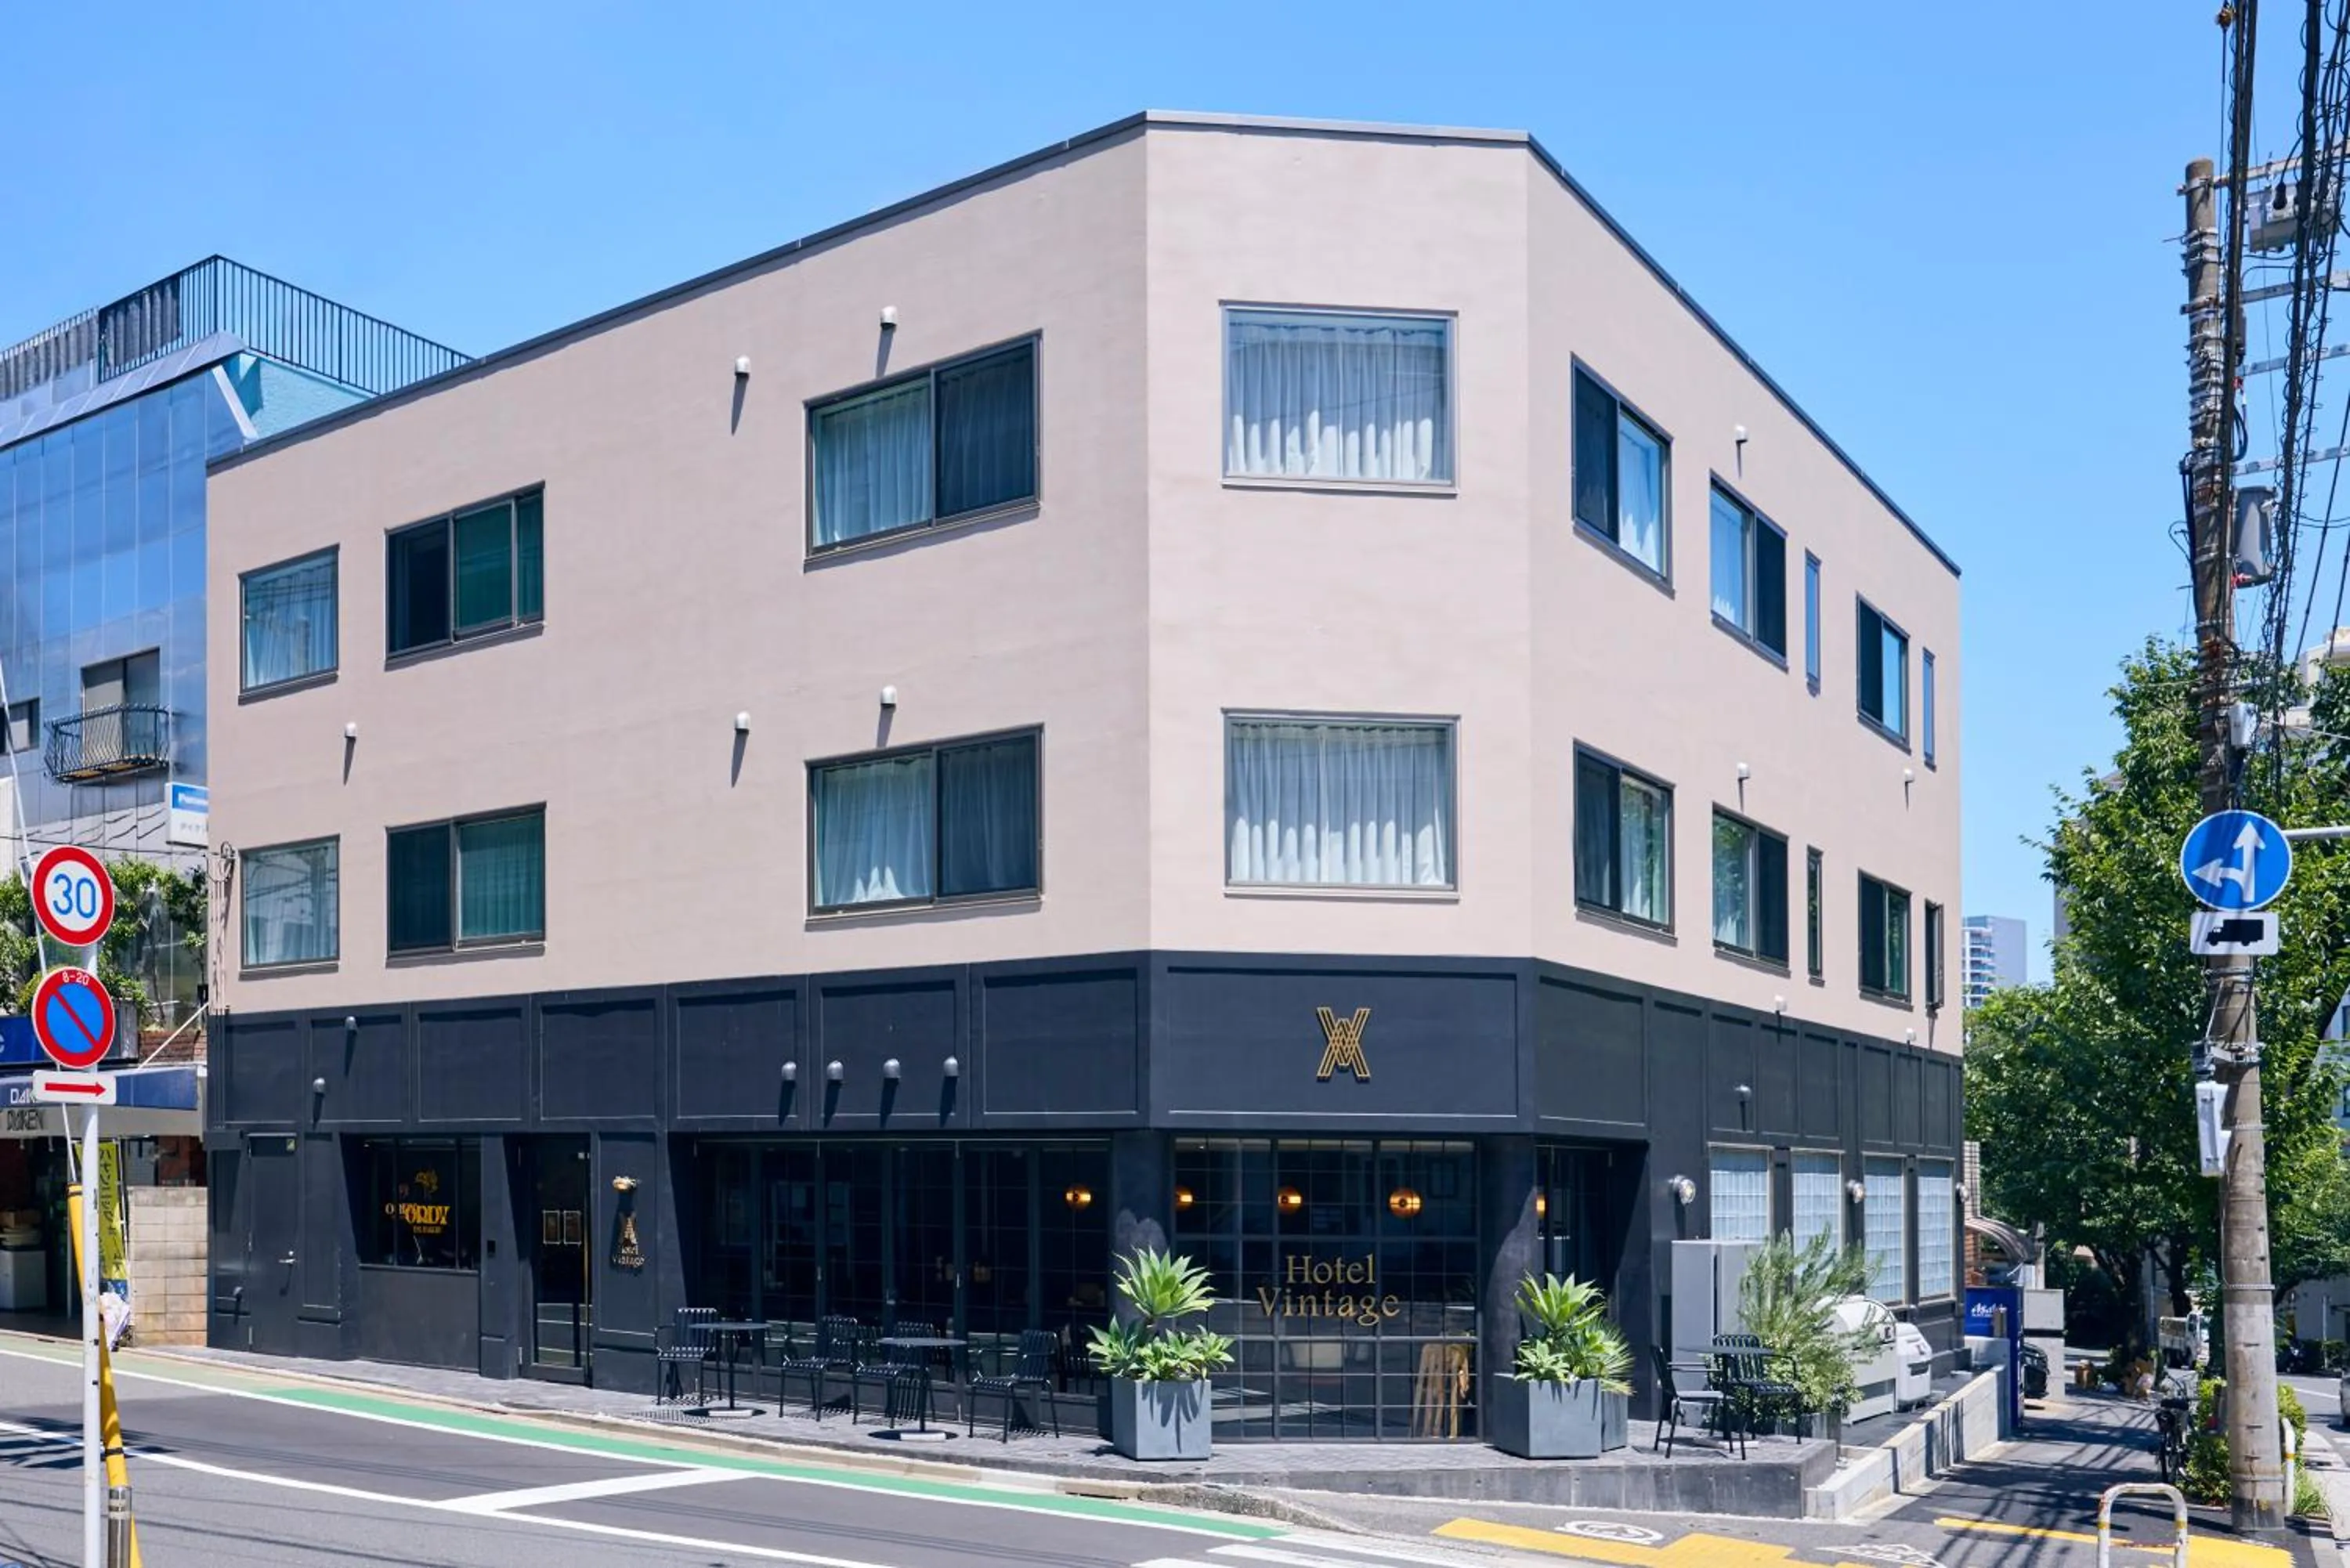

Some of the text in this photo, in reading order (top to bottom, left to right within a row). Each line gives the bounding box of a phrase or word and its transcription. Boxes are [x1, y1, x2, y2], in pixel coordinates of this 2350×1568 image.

[52, 873, 96, 919] 30
[62, 970, 90, 986] 8-20
[1285, 1253, 1377, 1284] Hotel
[1256, 1287, 1401, 1326] Vintage
